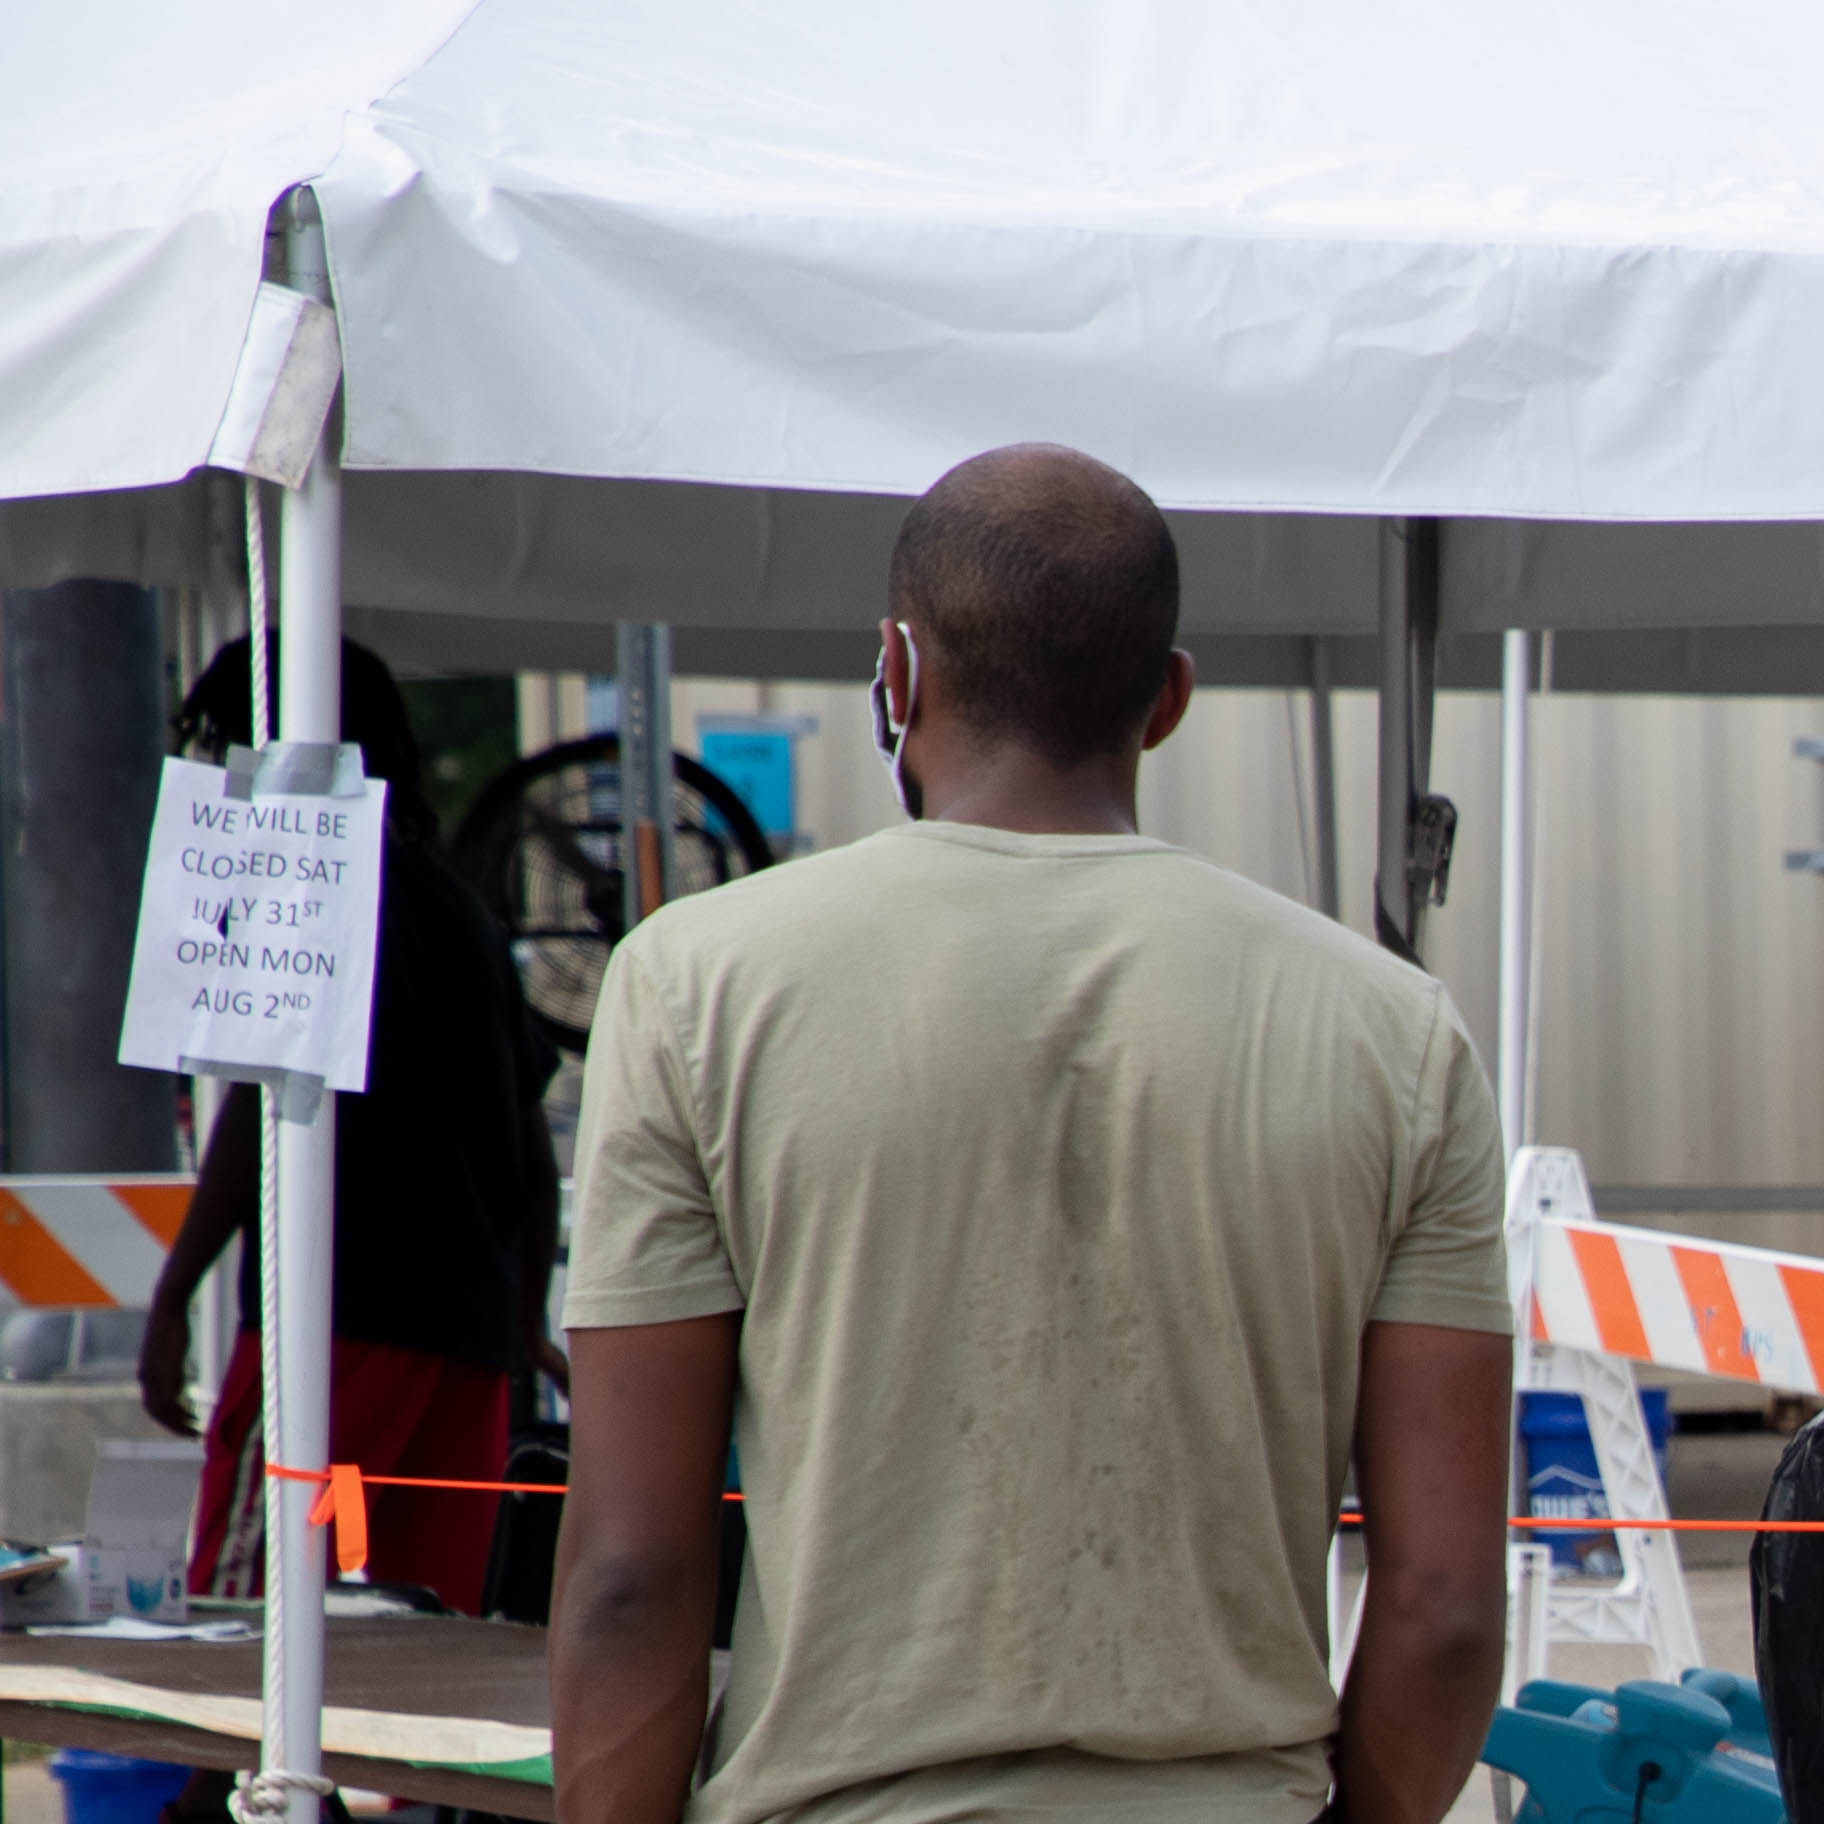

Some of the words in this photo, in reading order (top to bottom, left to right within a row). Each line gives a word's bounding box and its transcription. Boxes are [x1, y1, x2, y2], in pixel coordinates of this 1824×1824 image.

[192, 802, 238, 833] WE
[246, 806, 307, 834] WILL
[316, 813, 347, 838] BE
[181, 849, 287, 880] CLOSED
[296, 857, 347, 885] SAT
[265, 902, 324, 927] 31ST
[177, 940, 250, 968] OPEN
[261, 948, 335, 977] MON
[192, 988, 252, 1015] AUG
[264, 994, 311, 1019] 2ND
